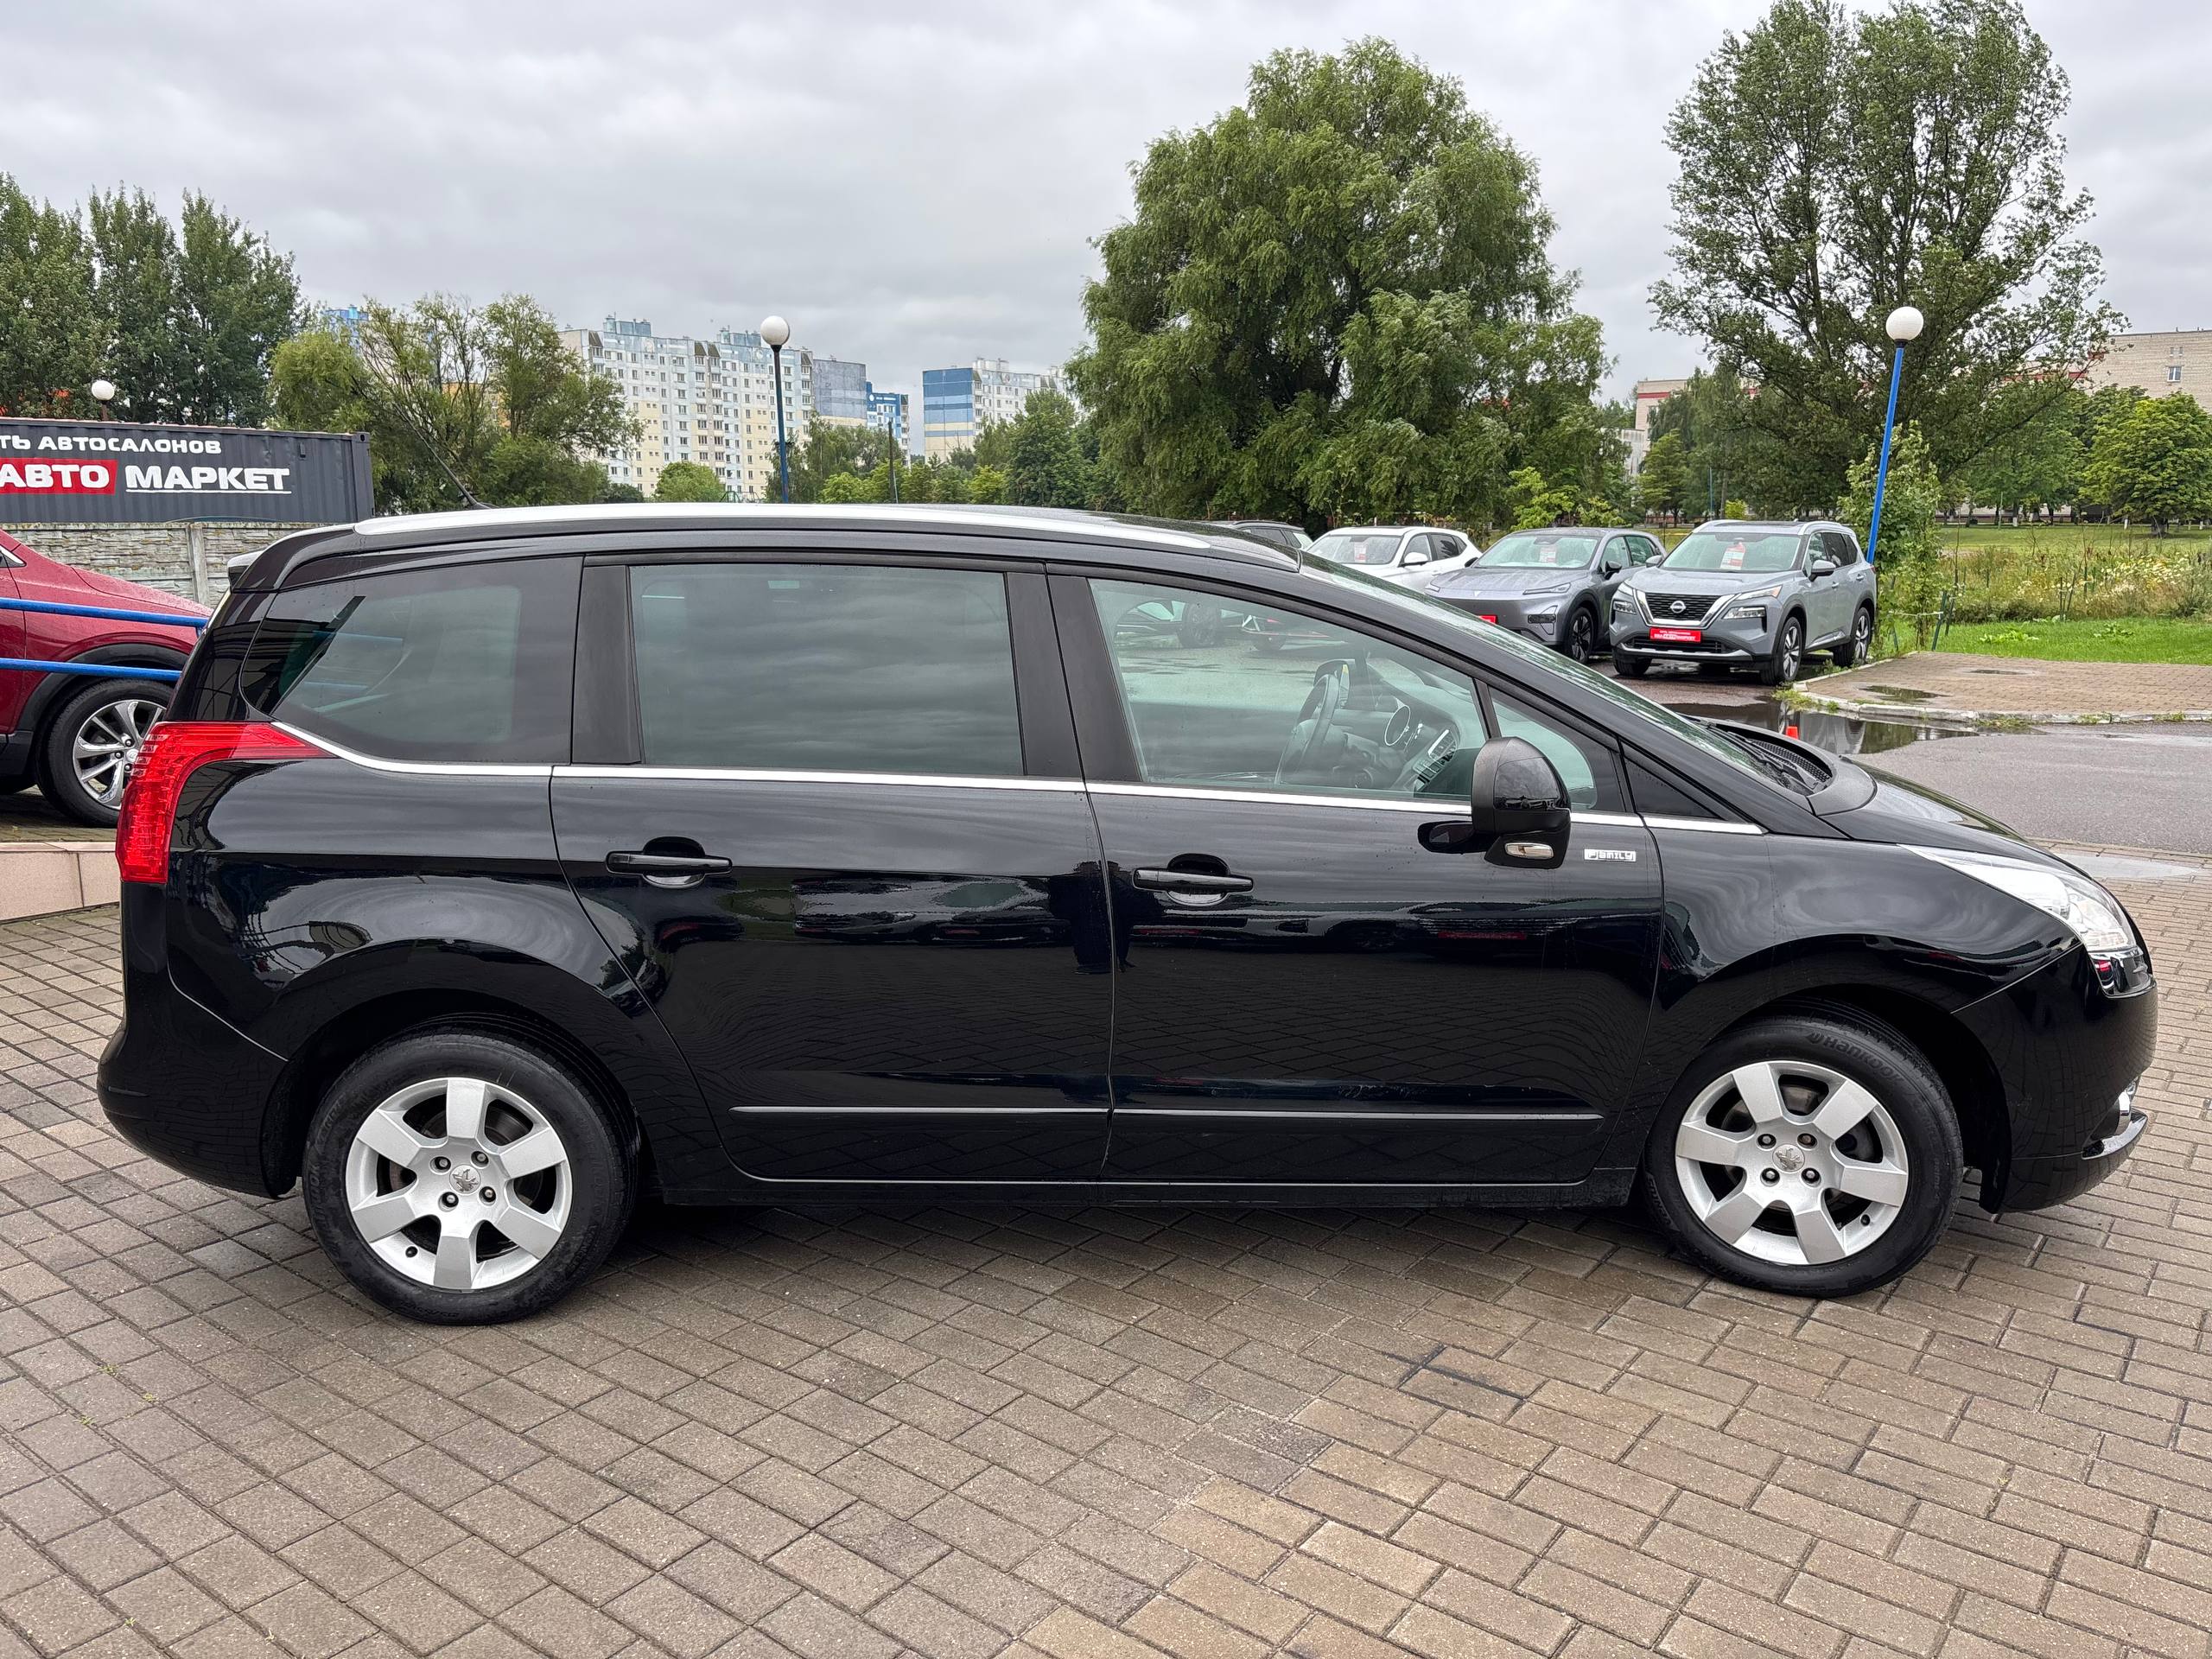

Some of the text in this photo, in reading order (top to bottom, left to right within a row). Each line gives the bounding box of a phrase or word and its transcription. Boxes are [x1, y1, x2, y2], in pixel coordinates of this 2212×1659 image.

[37, 435, 222, 454] АВТОСАЛОНОВ
[0, 463, 290, 491] АВТО МАРКЕТ
